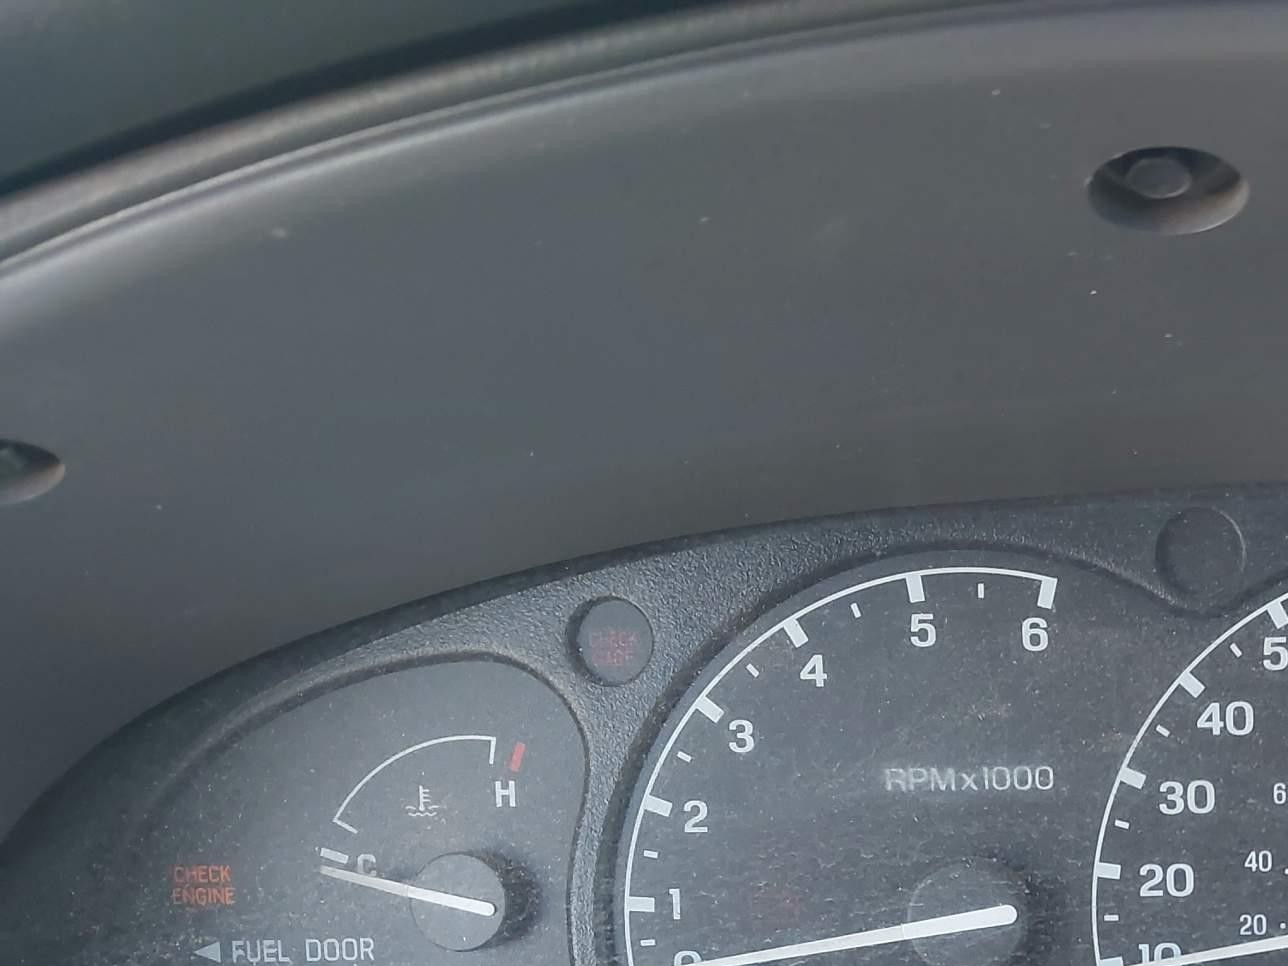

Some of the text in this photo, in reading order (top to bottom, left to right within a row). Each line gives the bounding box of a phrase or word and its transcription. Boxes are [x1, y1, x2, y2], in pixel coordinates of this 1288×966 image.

[909, 613, 937, 647] 5
[1021, 617, 1049, 652] 6
[799, 654, 828, 687] 4
[1197, 701, 1254, 736] 40
[728, 719, 755, 753] 3
[495, 780, 517, 808] H
[884, 766, 1055, 791] RPMx1000
[1159, 780, 1215, 815] 30
[683, 800, 709, 833] 2
[173, 865, 231, 883] CHECK
[356, 854, 377, 877] C
[1244, 850, 1272, 873] 40
[172, 887, 235, 905] ENGINE
[1139, 863, 1195, 898] 20
[669, 888, 681, 920] 1
[1239, 914, 1267, 936] 20
[232, 938, 375, 964] FUEL DOOR
